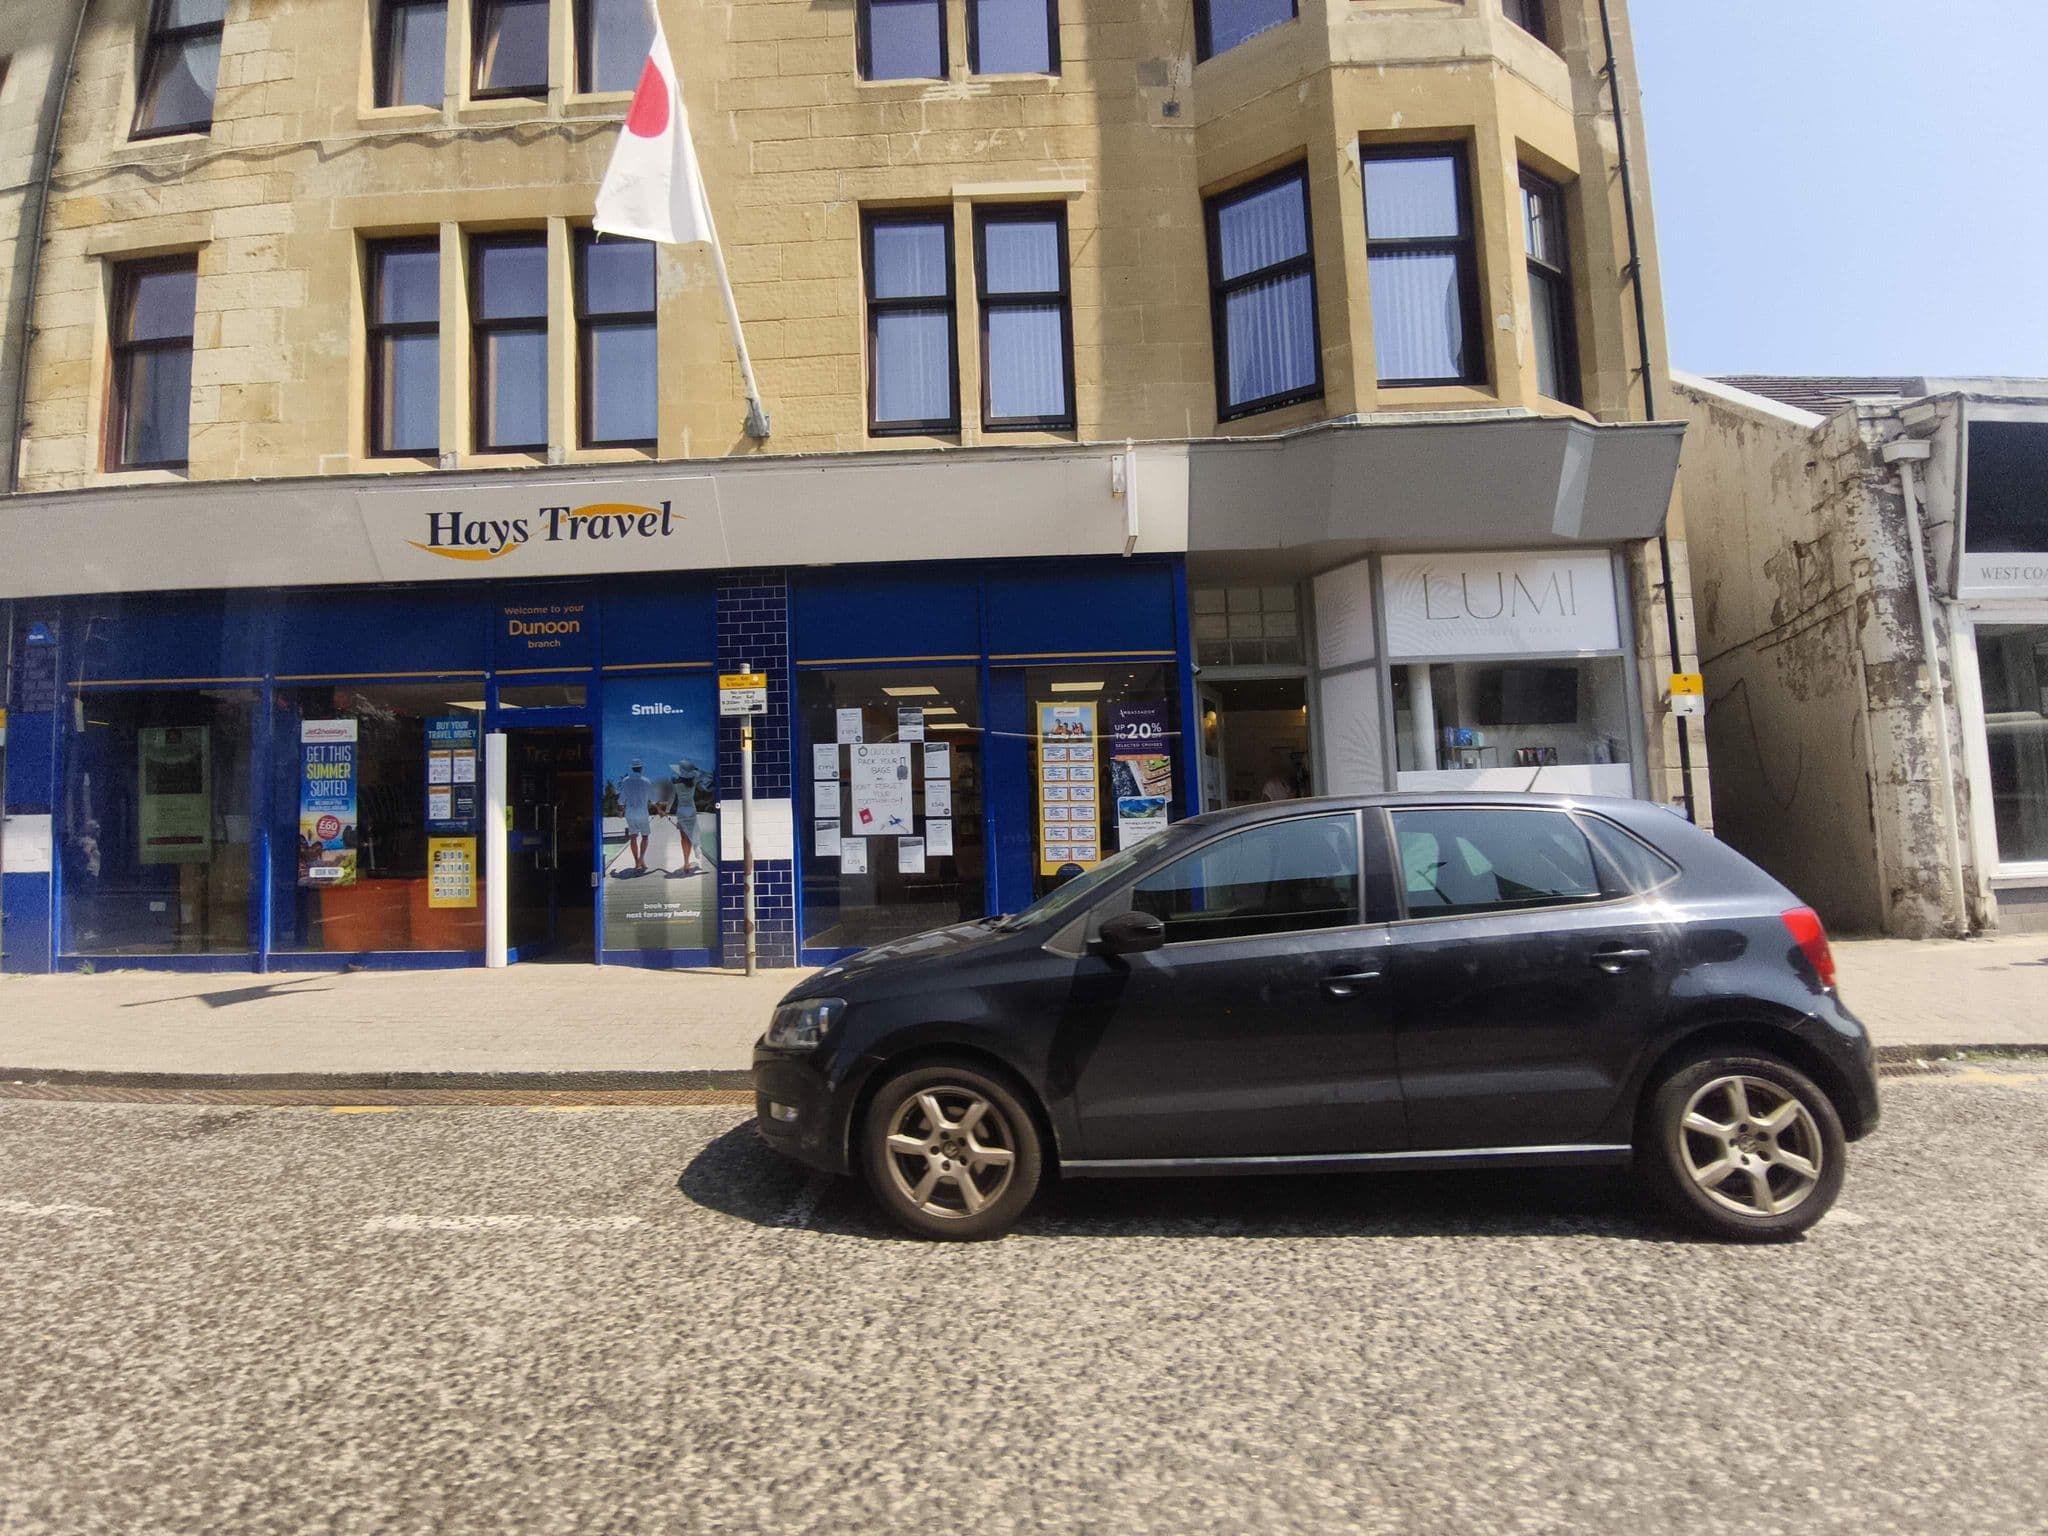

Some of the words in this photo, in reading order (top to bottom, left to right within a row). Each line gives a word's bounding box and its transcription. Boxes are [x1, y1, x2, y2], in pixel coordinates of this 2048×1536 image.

[424, 511, 530, 554] Hays
[539, 500, 674, 542] Travel
[1981, 566, 2021, 580] WEST
[1422, 569, 1577, 620] LUMI
[504, 605, 548, 615] Welcome
[550, 604, 561, 614] to
[563, 604, 584, 615] your
[508, 619, 580, 636] Dunoon
[527, 638, 561, 649] branch
[631, 702, 684, 716] Smile...
[436, 721, 449, 730] BUY
[452, 721, 469, 729] YOUR
[428, 730, 452, 739] TRAVEL
[453, 730, 477, 739] MONEY
[306, 745, 326, 762] GET
[329, 745, 352, 762] THIS
[306, 763, 351, 779] SUMMER
[872, 766, 892, 775] BAGS
[310, 780, 348, 797] SORTED
[320, 820, 338, 831] £60
[626, 911, 642, 919] next
[643, 911, 673, 919] faraway
[673, 910, 701, 918] holiday
